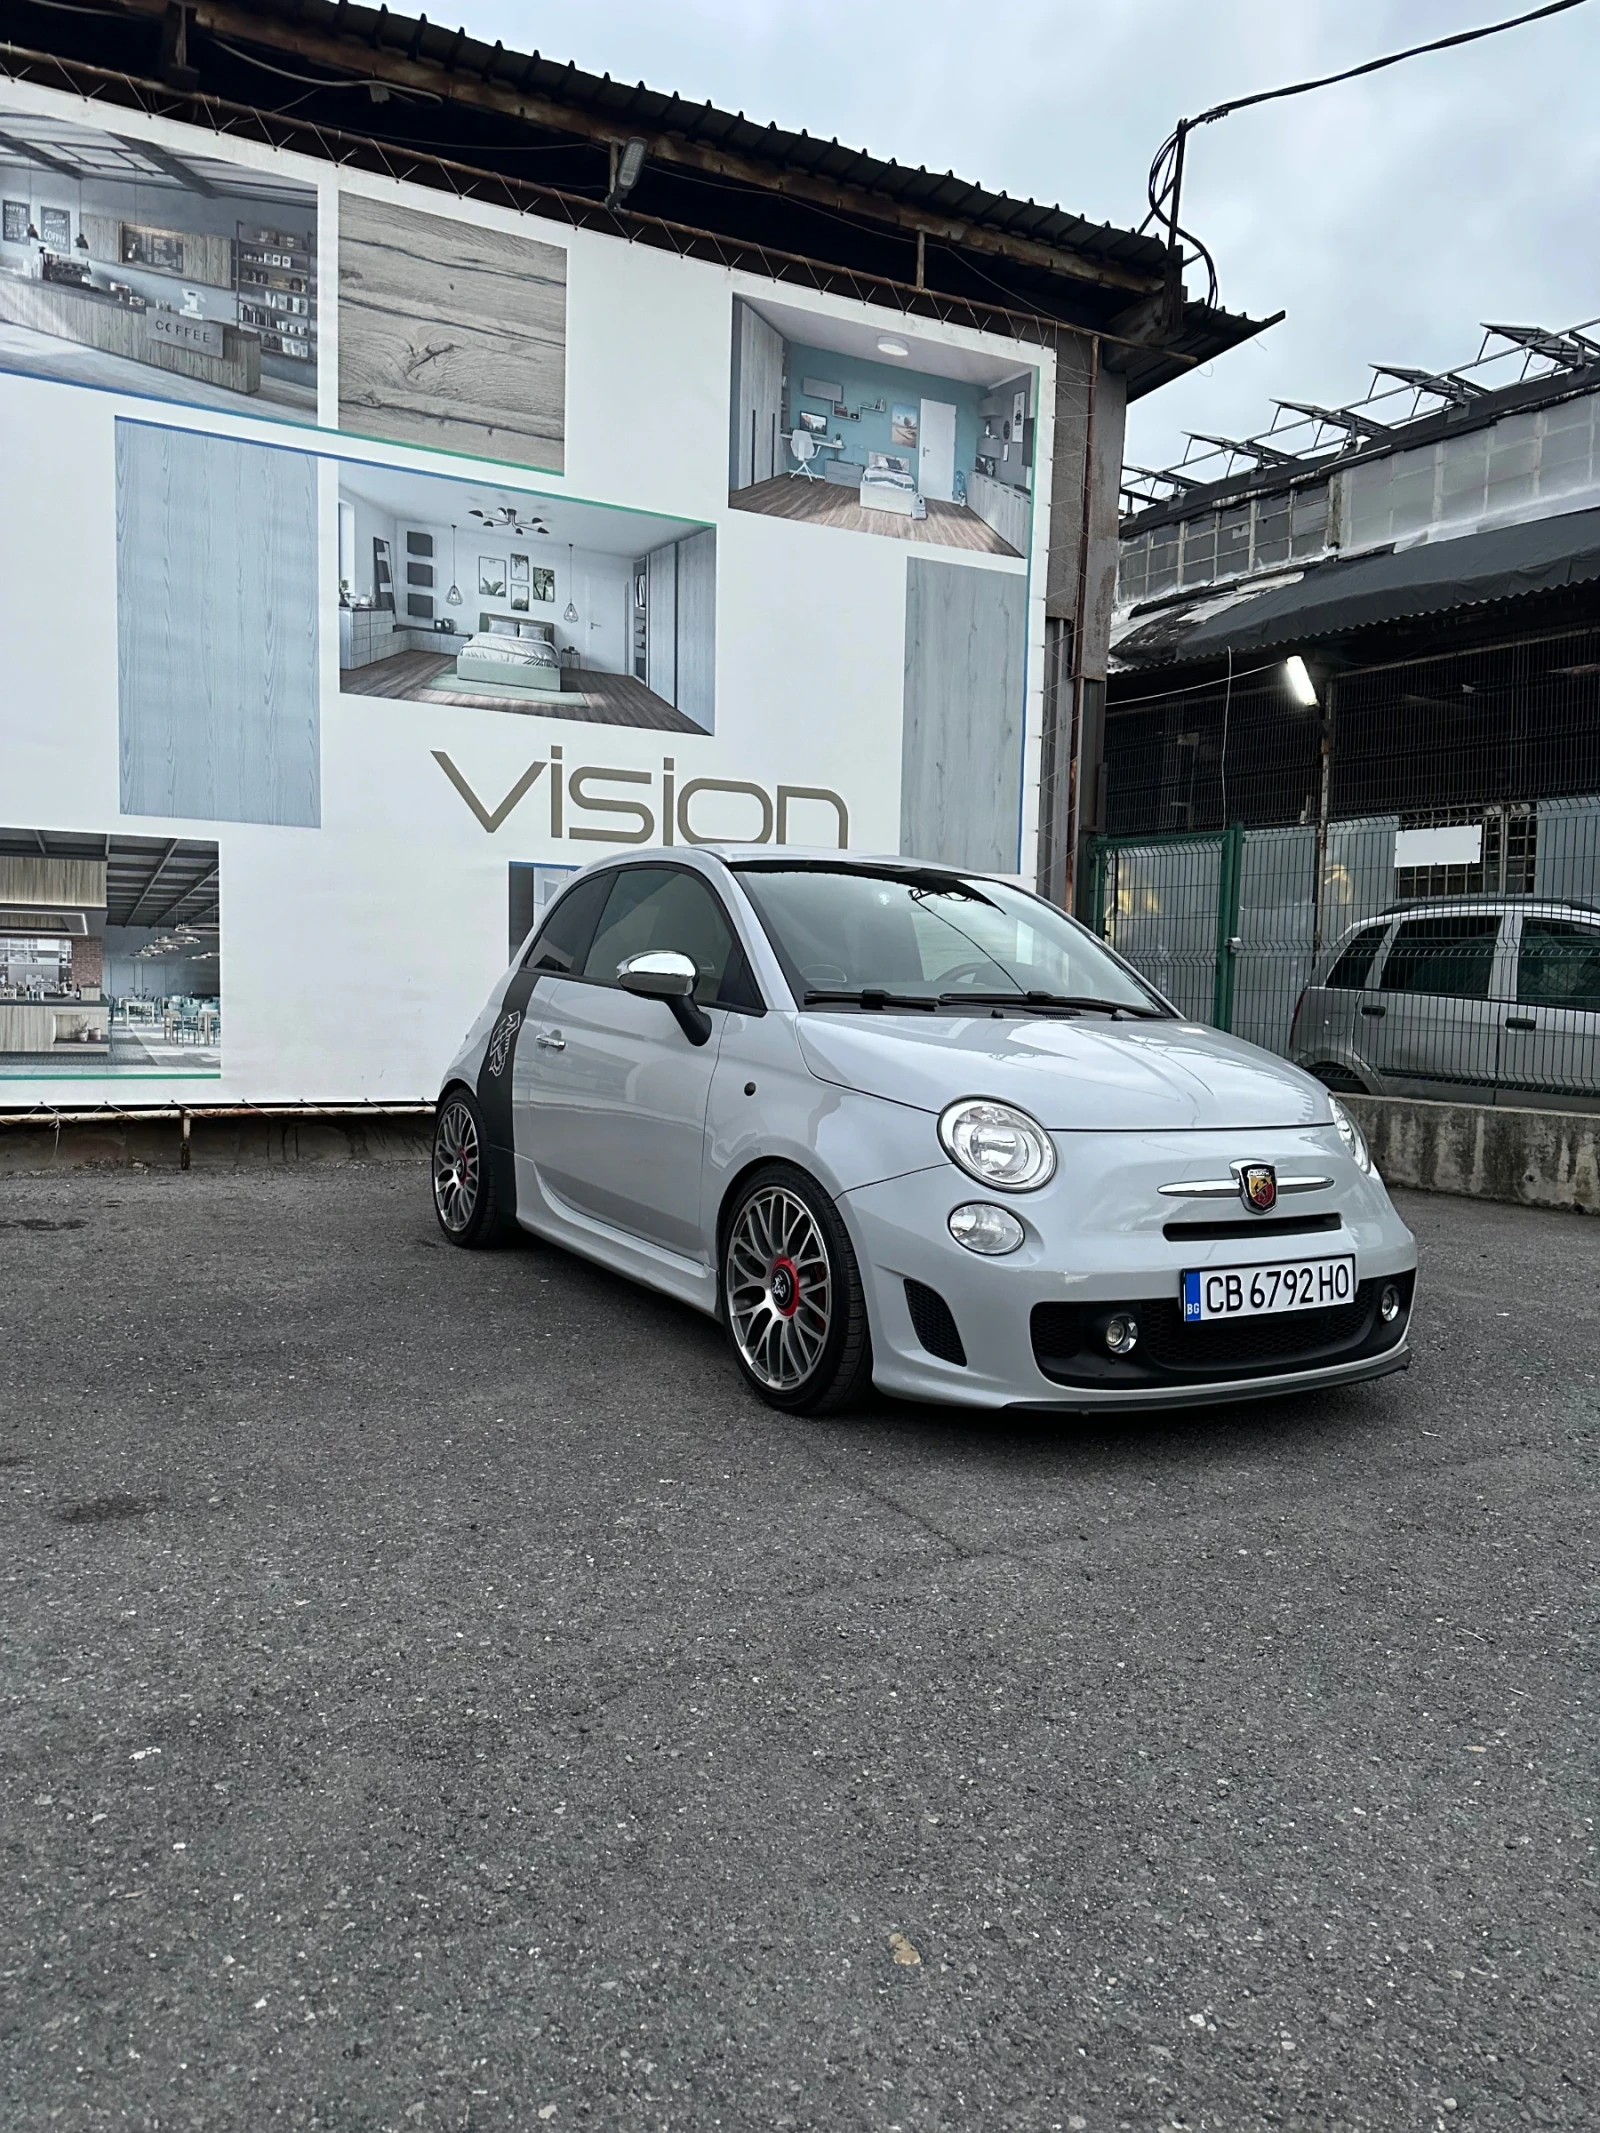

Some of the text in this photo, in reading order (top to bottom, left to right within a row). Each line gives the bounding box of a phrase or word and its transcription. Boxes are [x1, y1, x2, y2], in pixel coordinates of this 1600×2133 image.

[1206, 1263, 1349, 1313] CB 6792 HO
[1186, 1302, 1200, 1315] BG
